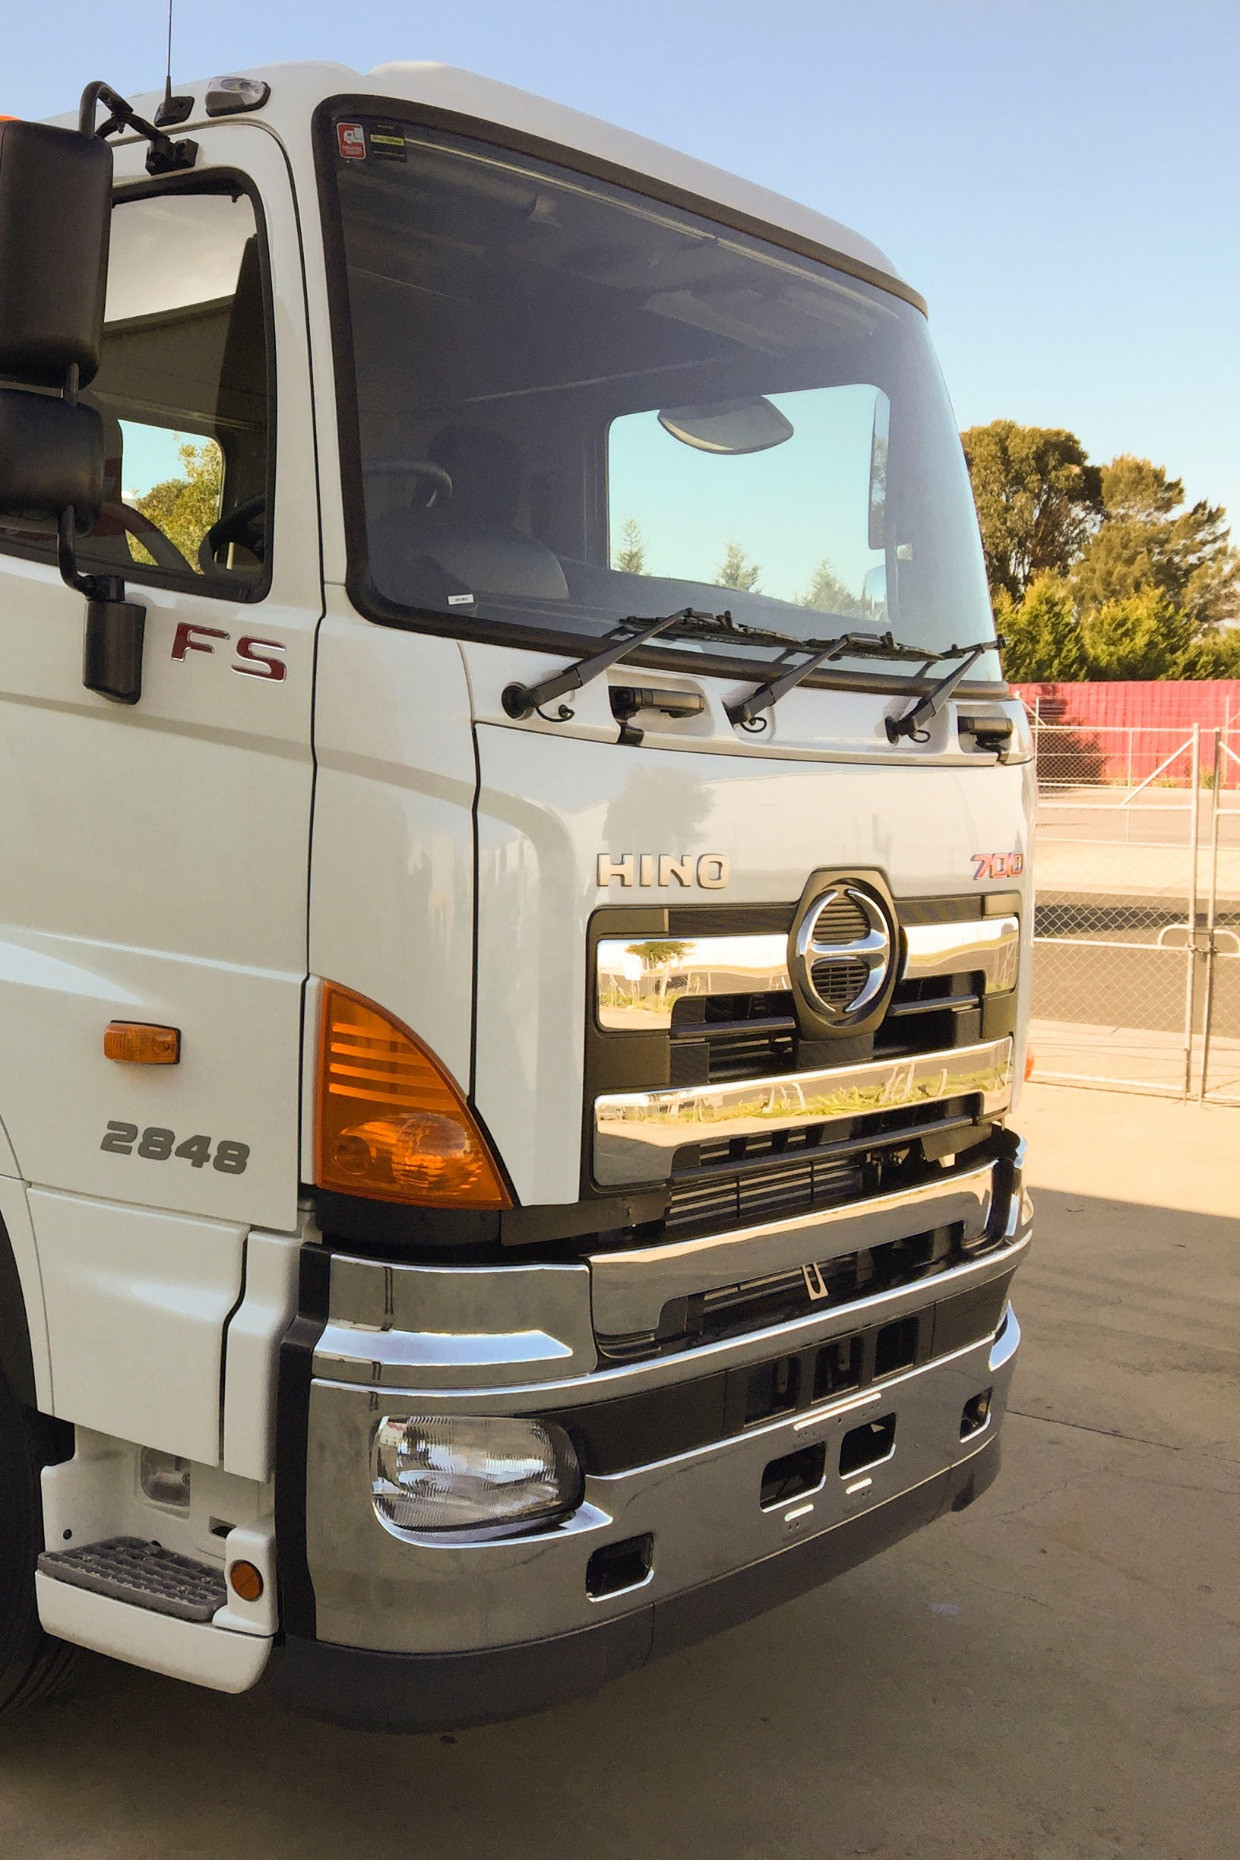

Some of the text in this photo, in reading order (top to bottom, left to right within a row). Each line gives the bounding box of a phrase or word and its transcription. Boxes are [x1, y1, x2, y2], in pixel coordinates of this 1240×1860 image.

[171, 621, 287, 683] FS
[596, 853, 730, 890] HINO
[970, 852, 1024, 881] 700
[100, 1120, 251, 1175] 2848
